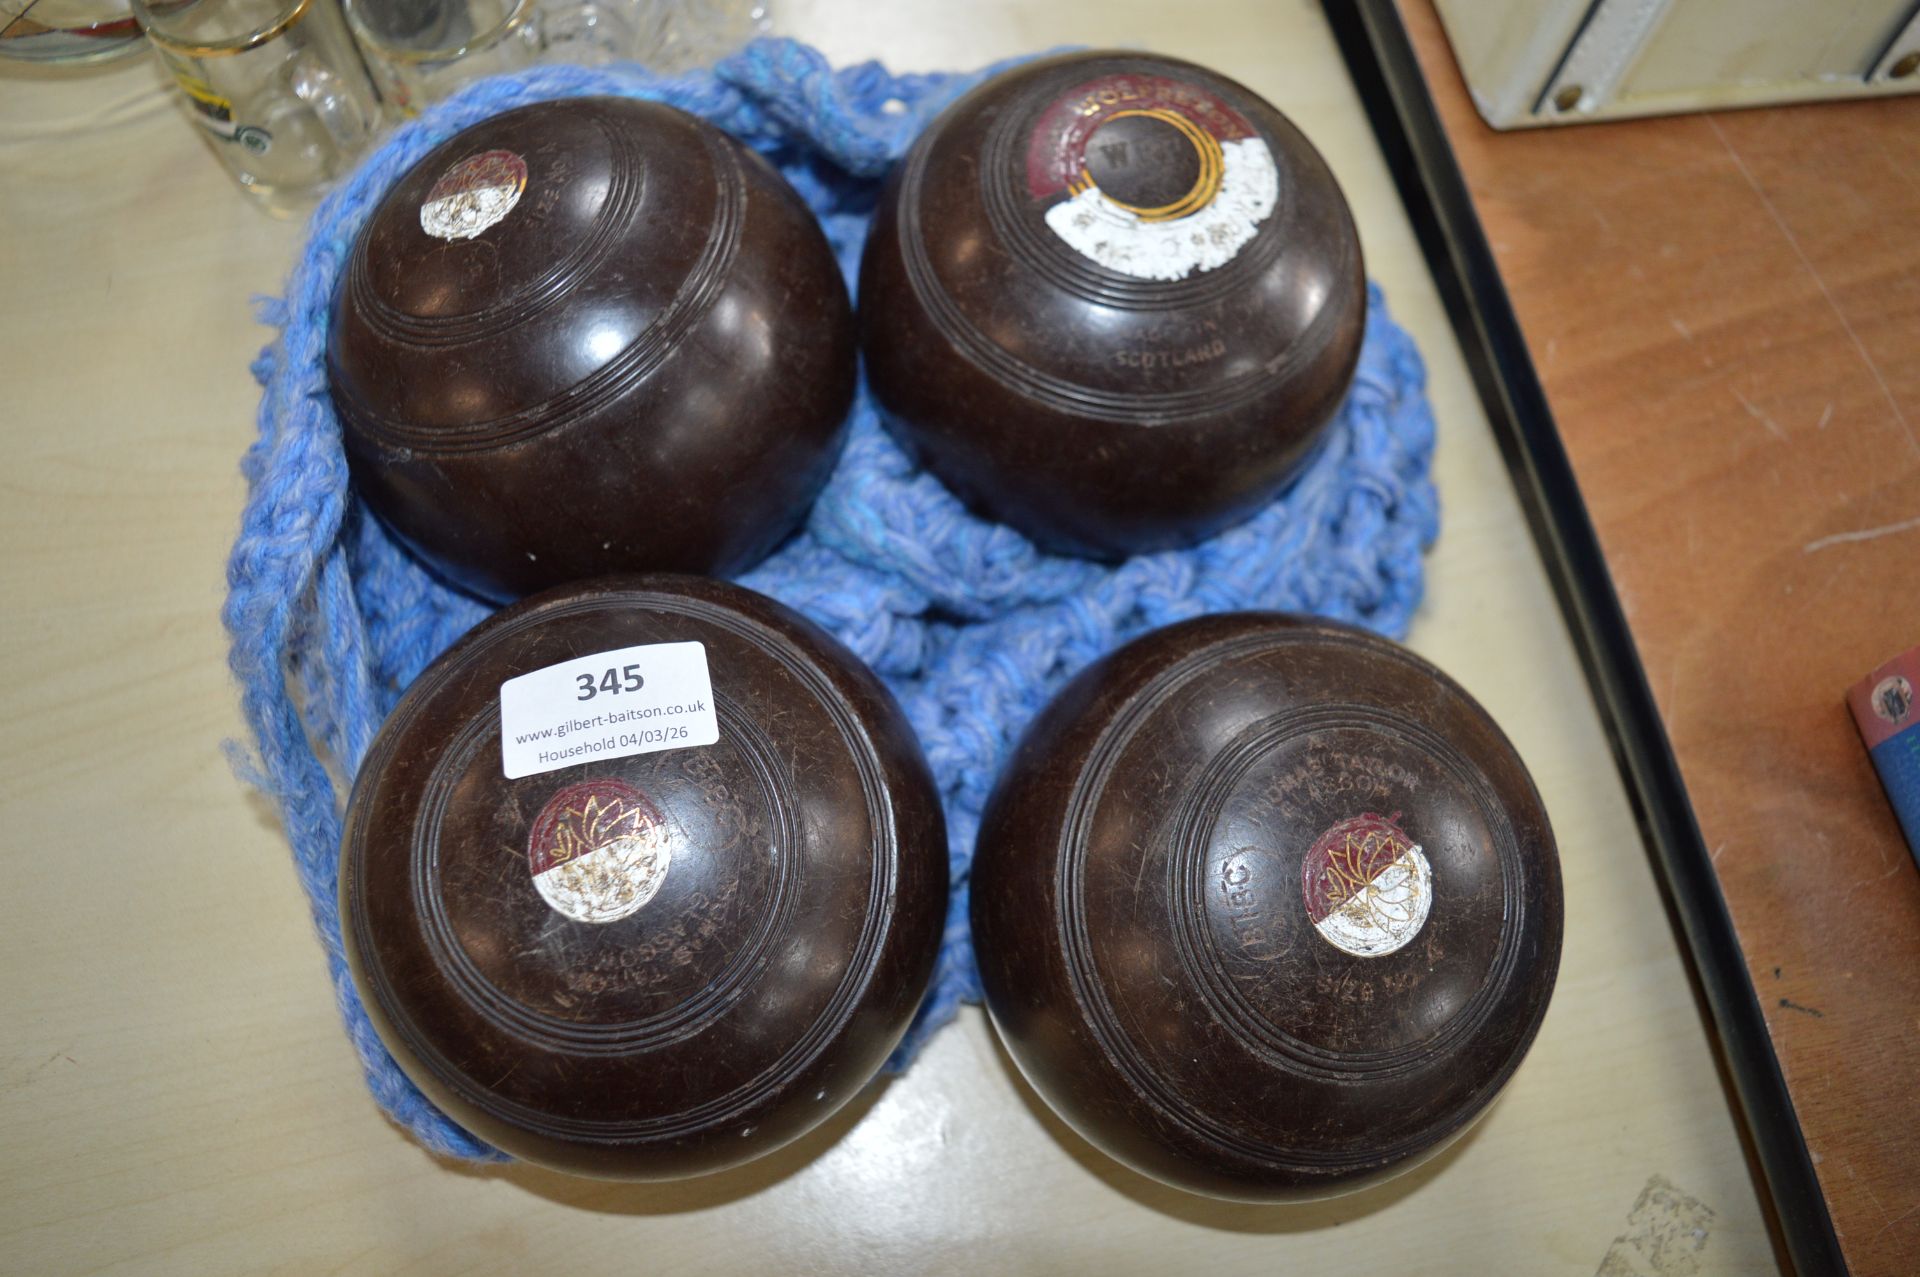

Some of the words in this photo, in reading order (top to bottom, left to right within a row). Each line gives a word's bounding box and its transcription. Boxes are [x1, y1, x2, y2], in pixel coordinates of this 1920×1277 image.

[1115, 339, 1227, 369] SCOTLAND
[576, 664, 645, 701] 345
[516, 700, 706, 745] www.gilbert-baitson.co.uk
[538, 737, 616, 764] Household
[619, 726, 689, 748] 04/03/26
